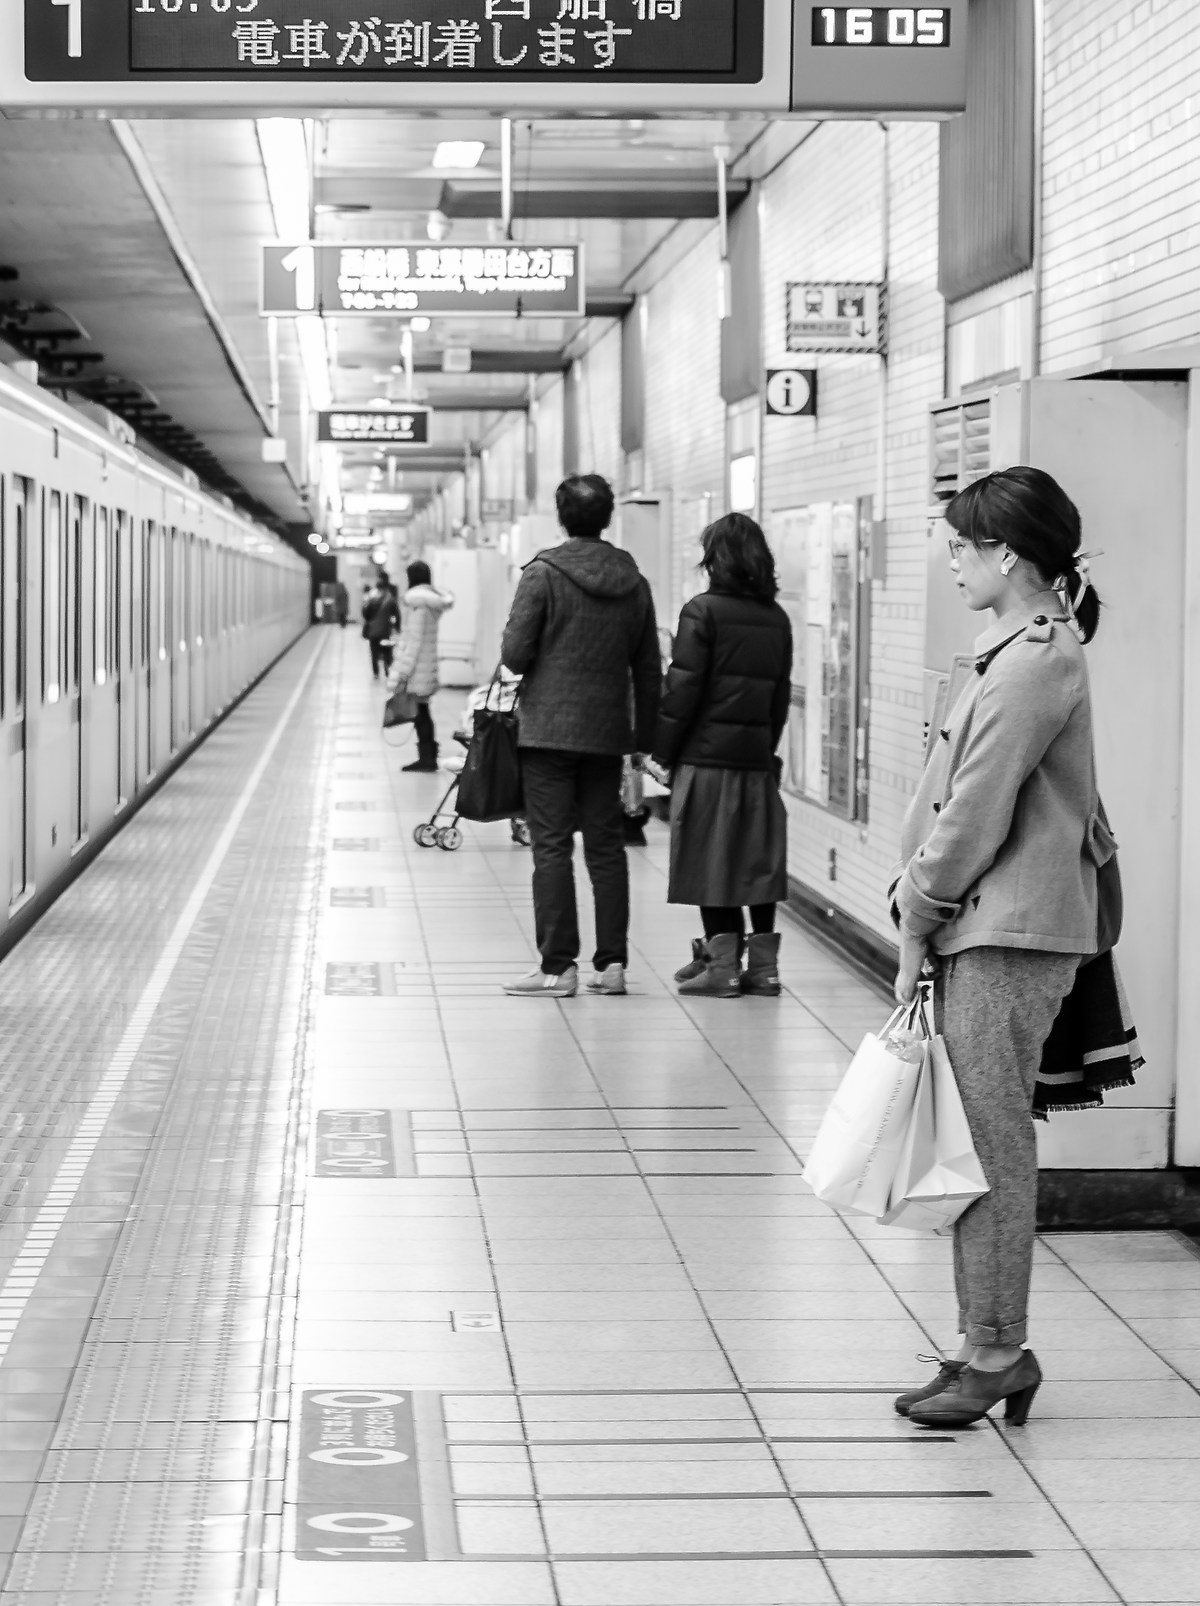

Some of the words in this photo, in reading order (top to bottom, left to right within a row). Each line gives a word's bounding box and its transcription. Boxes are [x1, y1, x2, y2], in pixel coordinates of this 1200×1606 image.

[231, 17, 632, 68] 電車が到着します
[281, 245, 316, 310] 1
